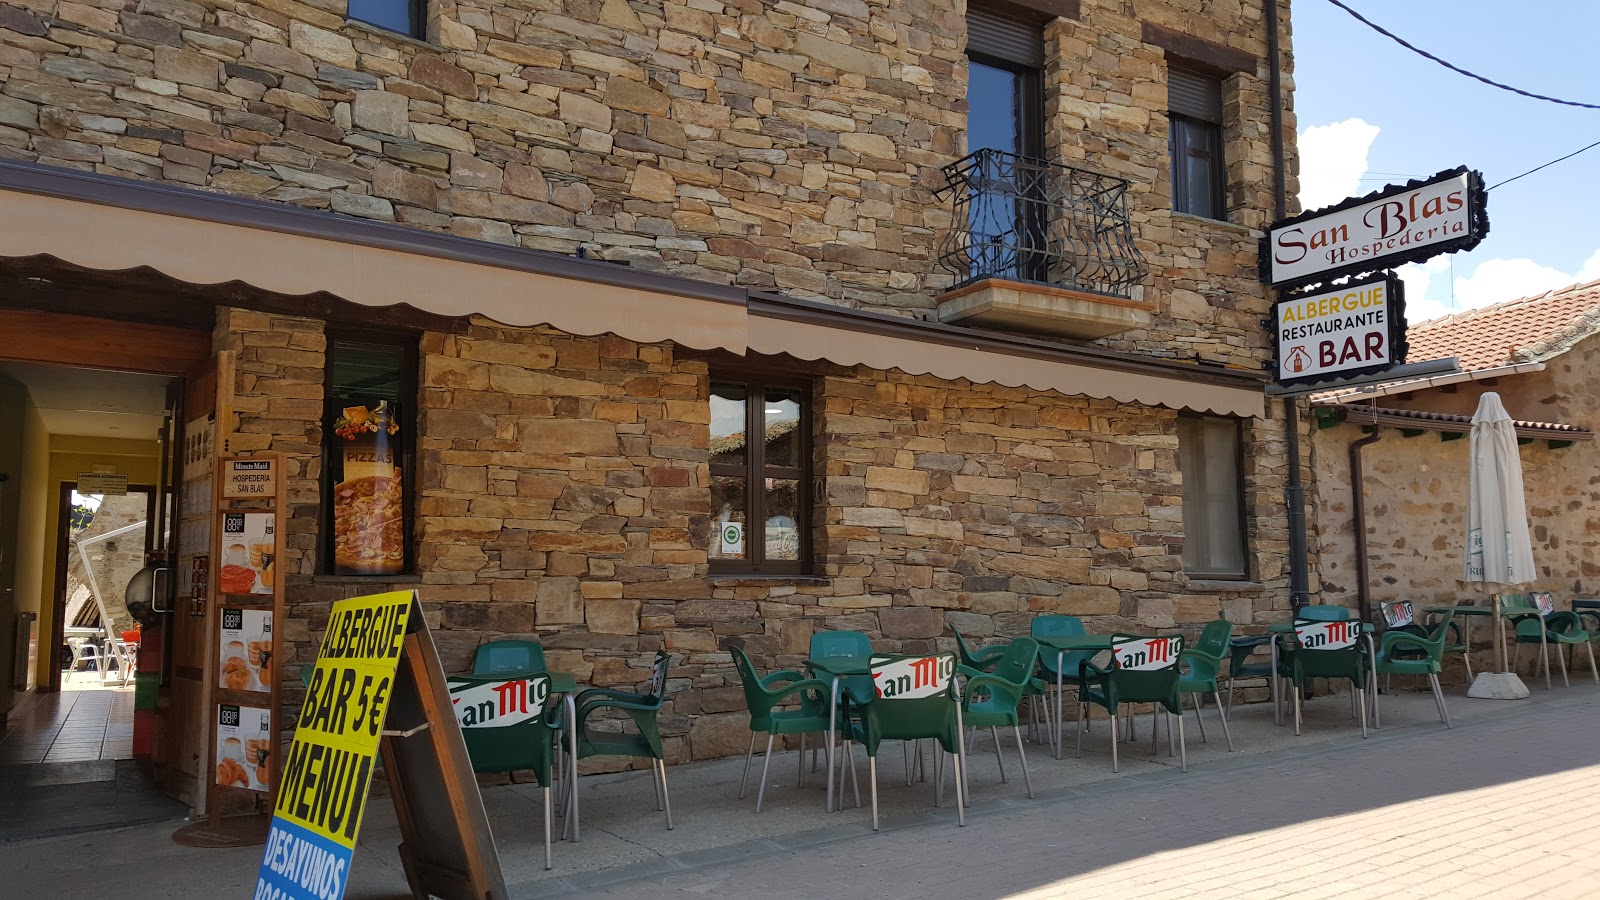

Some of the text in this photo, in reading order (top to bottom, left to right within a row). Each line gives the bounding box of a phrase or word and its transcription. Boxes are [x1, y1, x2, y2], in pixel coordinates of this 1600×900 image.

[1275, 191, 1464, 265] San Blas
[1325, 220, 1464, 265] Hospedería
[1282, 287, 1384, 324] ALBERGUE
[1282, 310, 1384, 342] RESTAURANTE
[1319, 331, 1385, 368] BAR
[234, 462, 254, 470] Minute
[346, 452, 392, 464] PIZZAS
[232, 474, 271, 483] HOSPEDERIA
[237, 484, 265, 493] SAN BLAS
[319, 603, 408, 659] ALBERGUE
[300, 667, 390, 737] BAR 5€
[263, 826, 346, 900] DESAYUNOS
